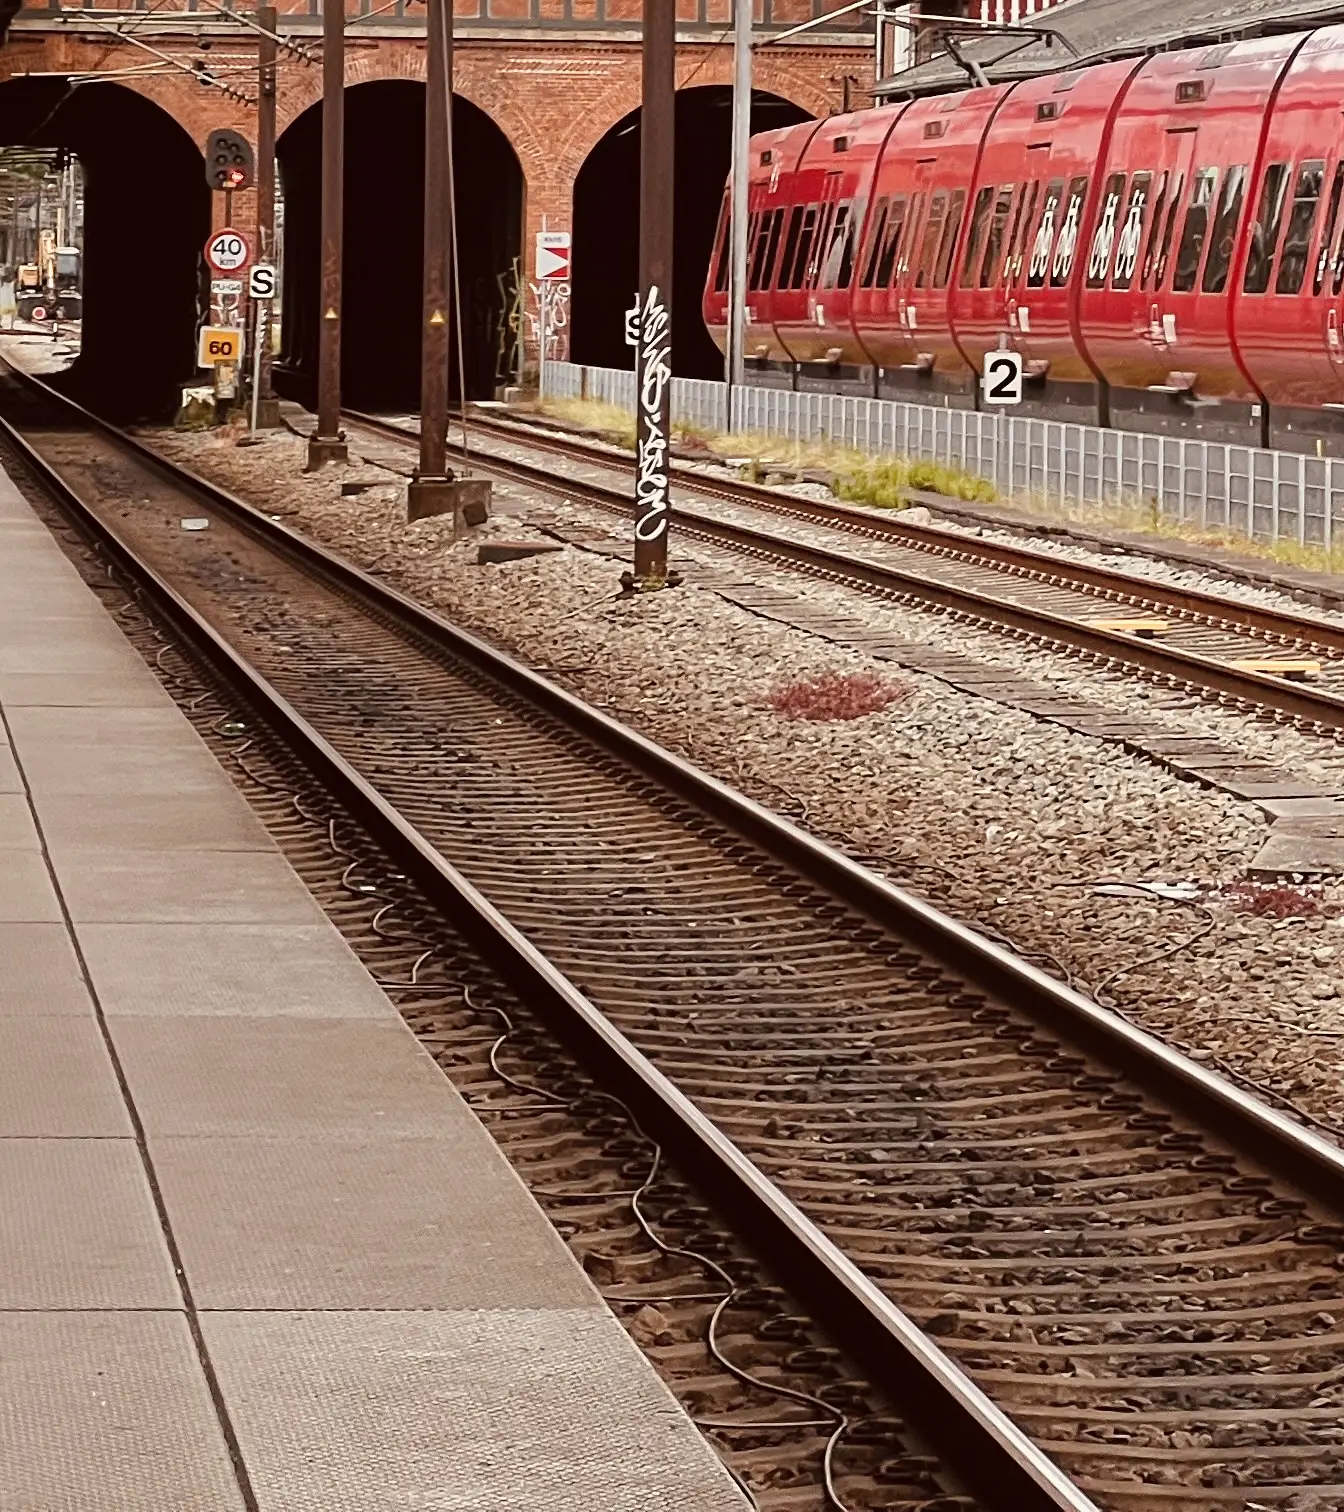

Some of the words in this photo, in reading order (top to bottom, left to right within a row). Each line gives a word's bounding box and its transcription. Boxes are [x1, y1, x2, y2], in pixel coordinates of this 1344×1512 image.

[212, 239, 242, 255] 40
[251, 269, 273, 294] S
[209, 341, 232, 356] 60
[989, 358, 1018, 397] 2
